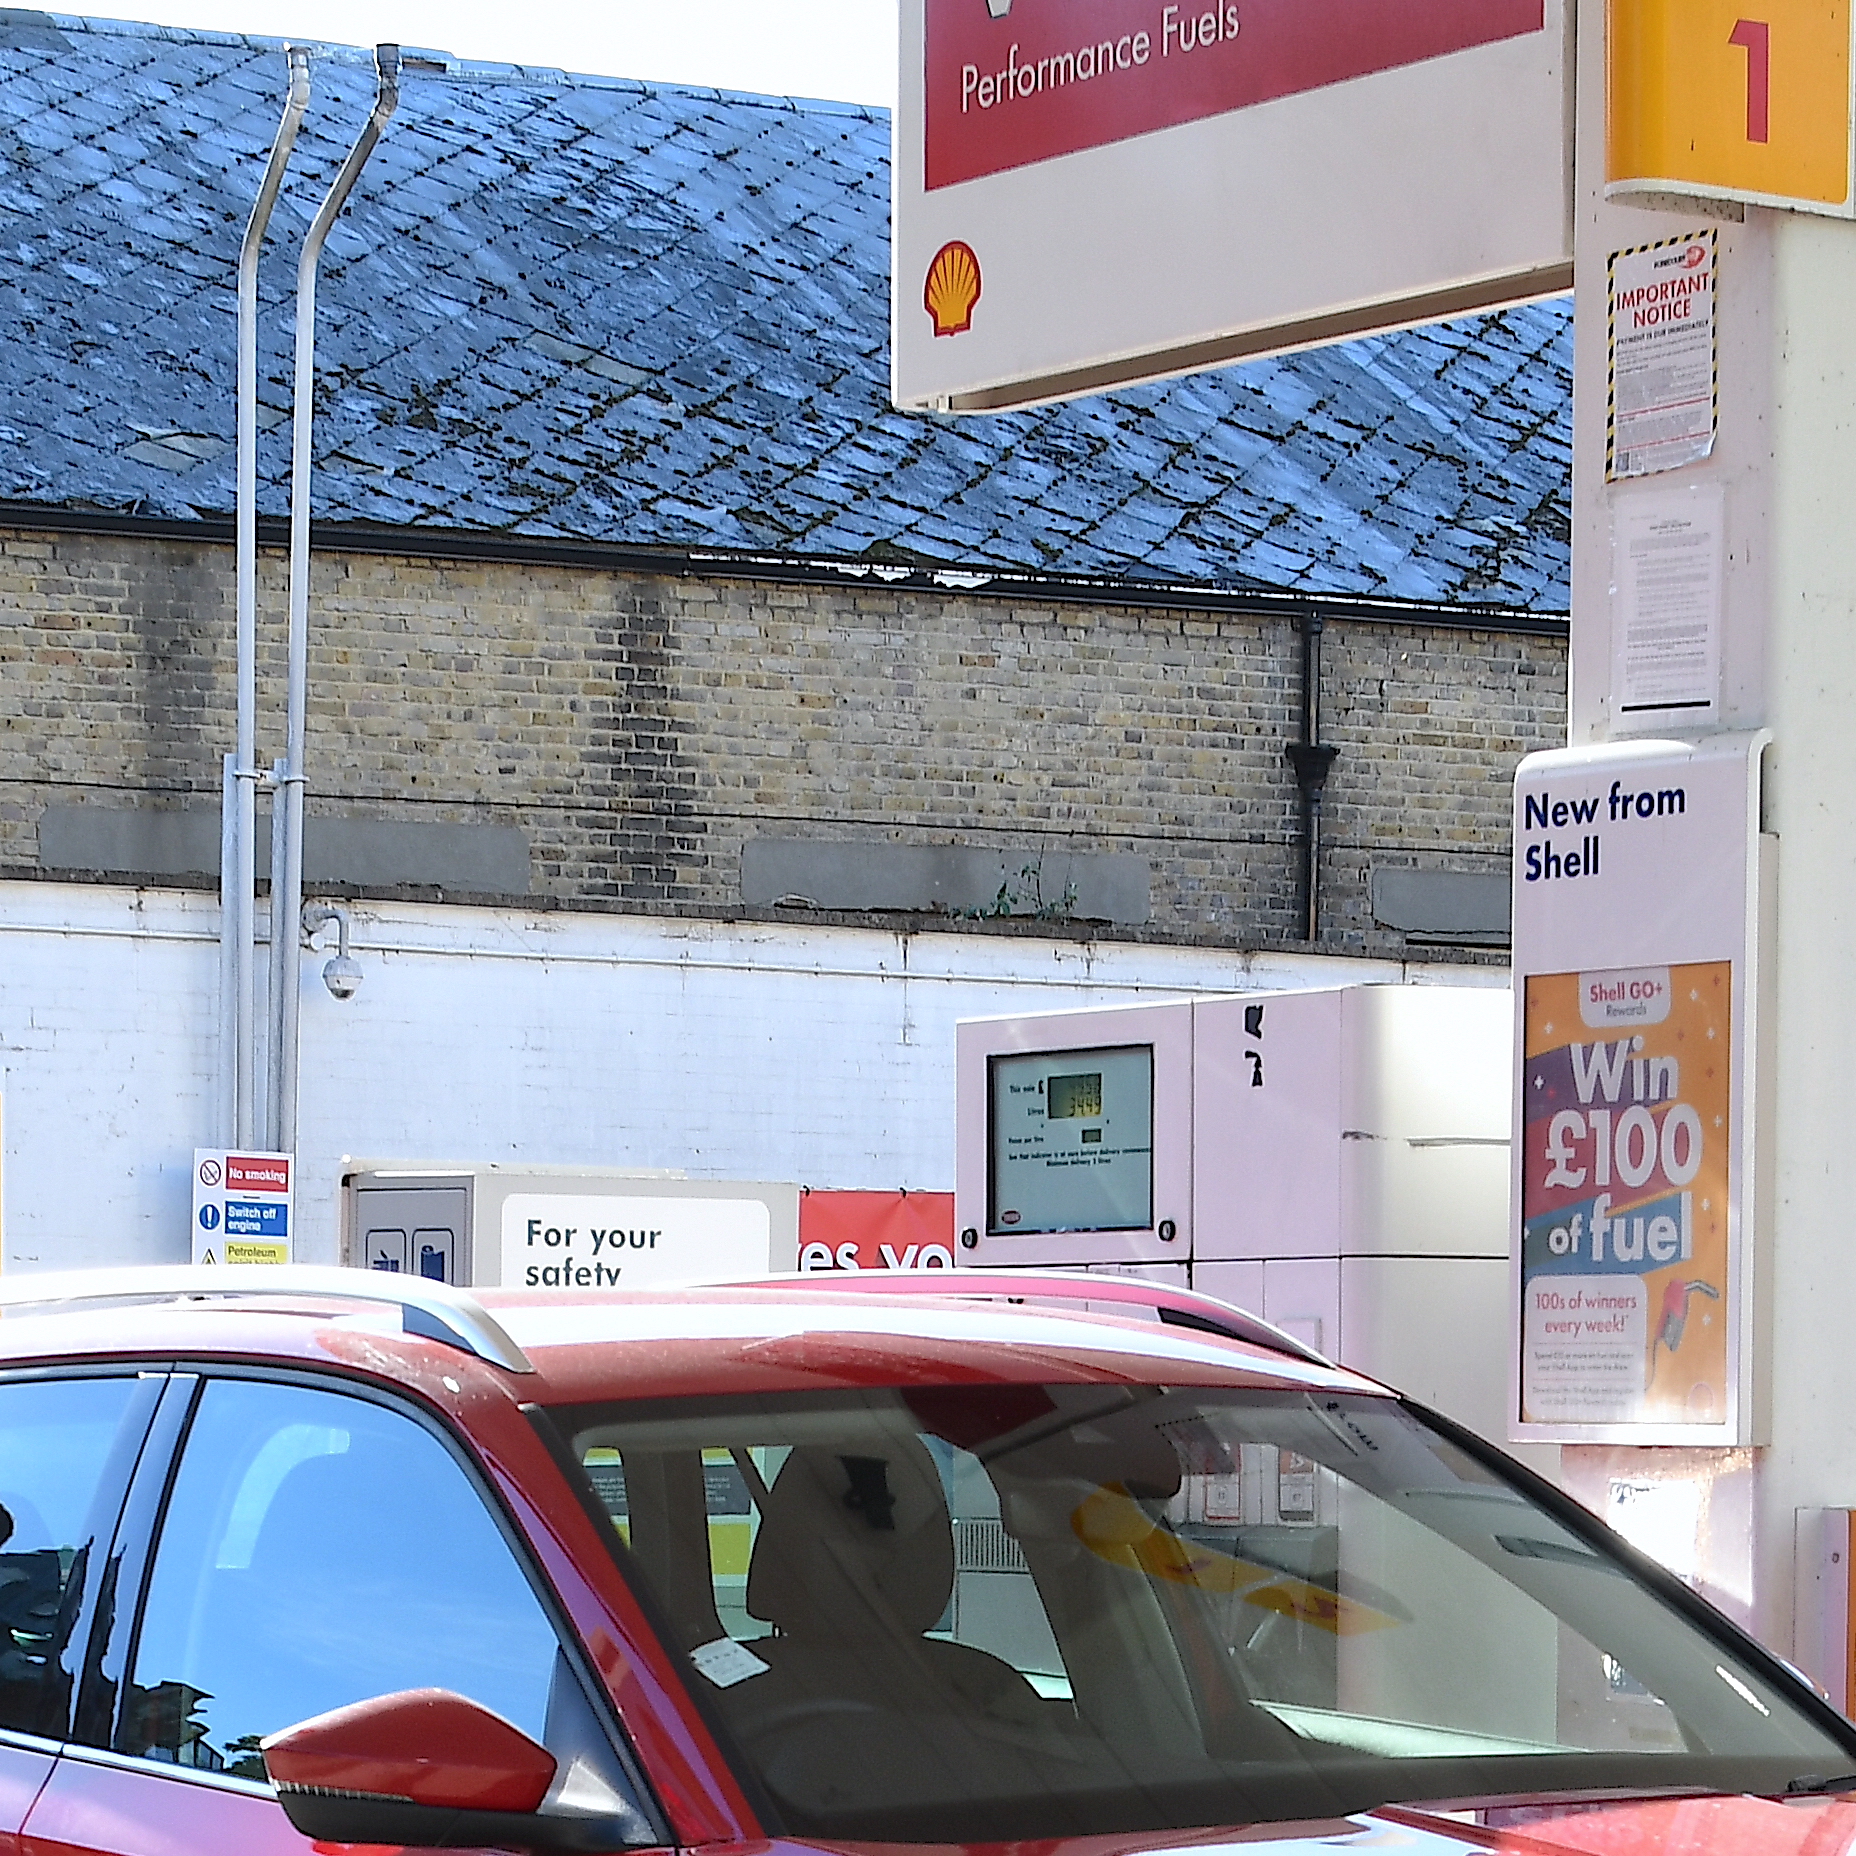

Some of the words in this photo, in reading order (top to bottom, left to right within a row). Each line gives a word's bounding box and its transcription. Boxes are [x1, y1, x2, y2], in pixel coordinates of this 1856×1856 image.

[960, 29, 1151, 114] Performance
[1161, 0, 1239, 57] Fuels
[1728, 19, 1771, 144] 1
[1616, 272, 1709, 311] IMPORTANT
[1633, 299, 1691, 329] NOTICE
[1524, 794, 1599, 830] New
[1608, 782, 1685, 820] from
[1524, 836, 1600, 882] Shell
[1589, 983, 1625, 1003] Shell
[1628, 981, 1663, 1002] GO+
[1605, 1002, 1647, 1018] Rewards
[1569, 1035, 1679, 1104] Win
[1544, 1104, 1702, 1190] £100
[229, 1168, 243, 1179] No
[245, 1170, 286, 1184] smoking
[228, 1206, 261, 1219] Switch
[263, 1208, 277, 1219] off
[228, 1220, 261, 1232] engine
[1548, 1216, 1585, 1255] of
[1589, 1191, 1692, 1262] fuel
[228, 1245, 276, 1258] Petroleum
[527, 1219, 577, 1247] For
[590, 1227, 662, 1255] your
[797, 1241, 861, 1270] es
[525, 1257, 622, 1287] safety
[1536, 1292, 1565, 1310] 100s
[1568, 1290, 1582, 1310] of
[1585, 1292, 1637, 1309] winners
[1545, 1321, 1581, 1338] every
